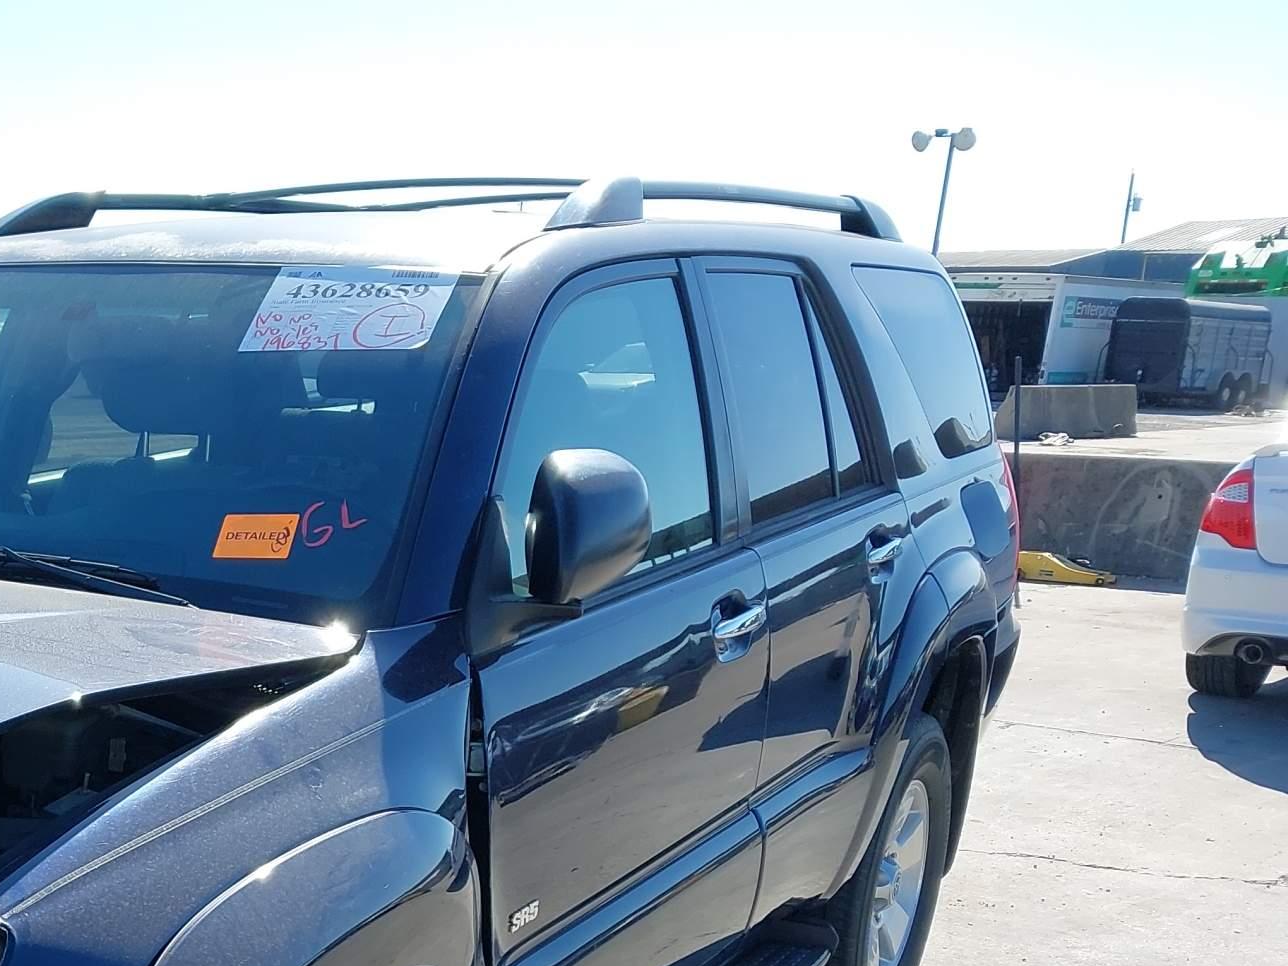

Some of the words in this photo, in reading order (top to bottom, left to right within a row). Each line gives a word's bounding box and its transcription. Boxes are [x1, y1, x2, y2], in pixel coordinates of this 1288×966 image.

[286, 283, 430, 299] 43628659
[225, 530, 289, 541] DETAILED
[509, 898, 540, 934] SR5
